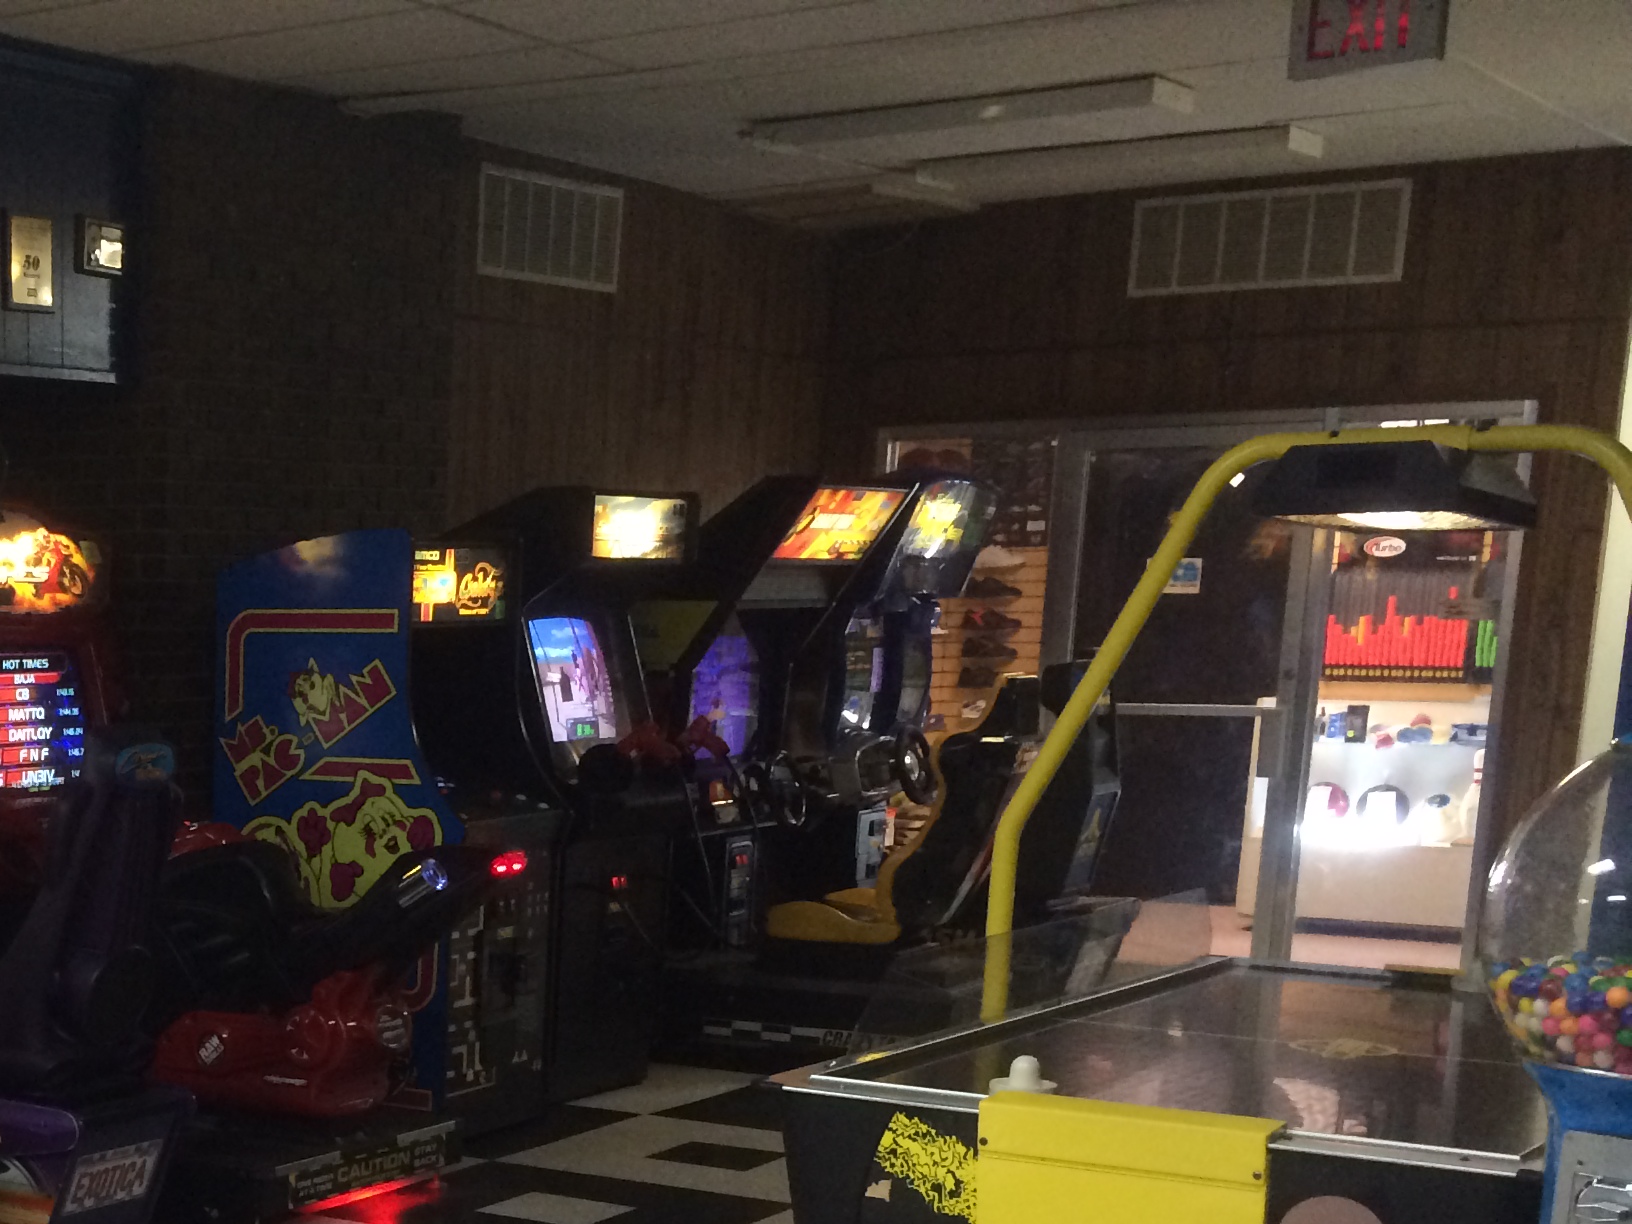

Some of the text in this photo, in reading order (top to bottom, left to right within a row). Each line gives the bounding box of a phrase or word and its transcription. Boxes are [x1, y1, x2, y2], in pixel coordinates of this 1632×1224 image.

[3, 658, 50, 670] HOT TIMES
[13, 673, 36, 684] BAJA
[337, 1150, 412, 1183] CAUTION
[70, 1158, 148, 1205] EXOTICA
